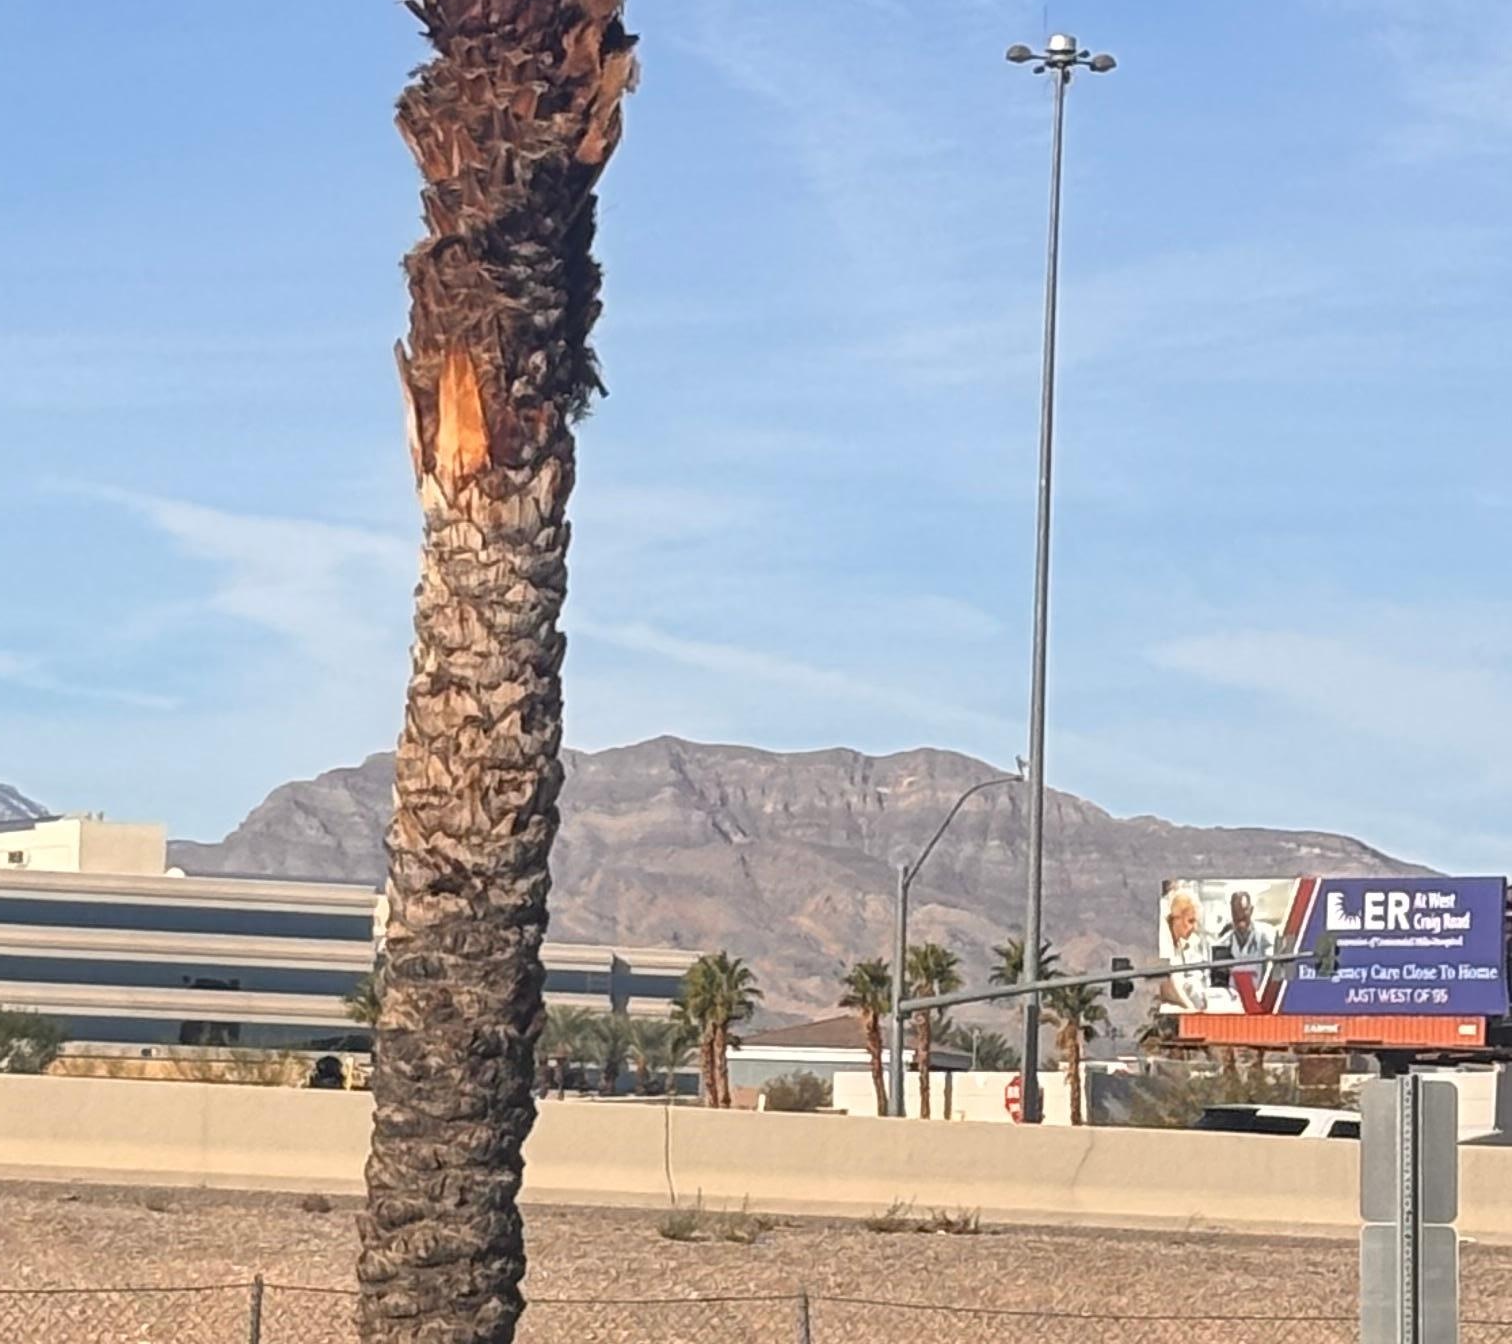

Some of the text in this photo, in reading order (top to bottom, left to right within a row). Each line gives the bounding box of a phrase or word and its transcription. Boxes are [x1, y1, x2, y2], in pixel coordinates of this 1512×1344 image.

[1413, 911, 1470, 934] Craig Road
[1371, 964, 1400, 980] Care
[1403, 964, 1437, 980] Close
[1439, 964, 1455, 980] To
[1458, 964, 1498, 980] Home
[1345, 988, 1376, 1004] JUST
[1378, 988, 1412, 1004] WEST
[1414, 988, 1430, 1004] OF
